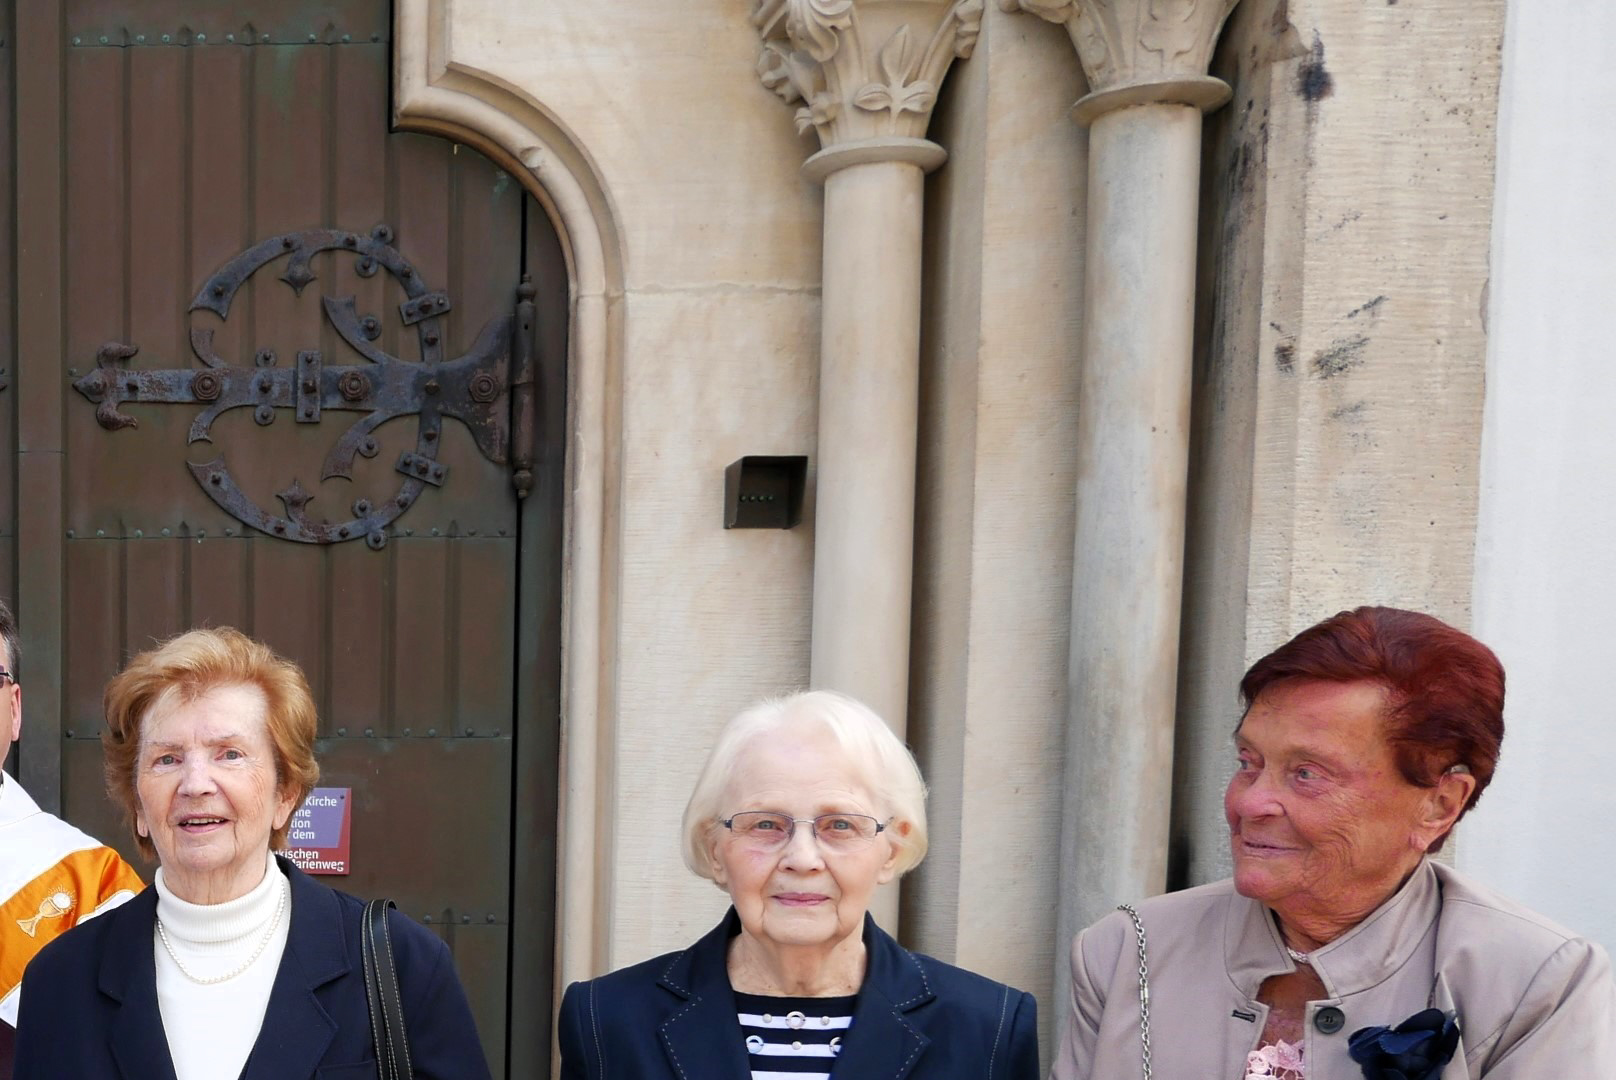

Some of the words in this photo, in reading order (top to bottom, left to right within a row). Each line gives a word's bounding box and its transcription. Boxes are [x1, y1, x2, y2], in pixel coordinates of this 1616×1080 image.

[305, 796, 337, 806] Kirche
[295, 808, 311, 817] ine
[291, 818, 310, 828] tion
[292, 829, 315, 839] dem
[276, 848, 318, 859] kischen
